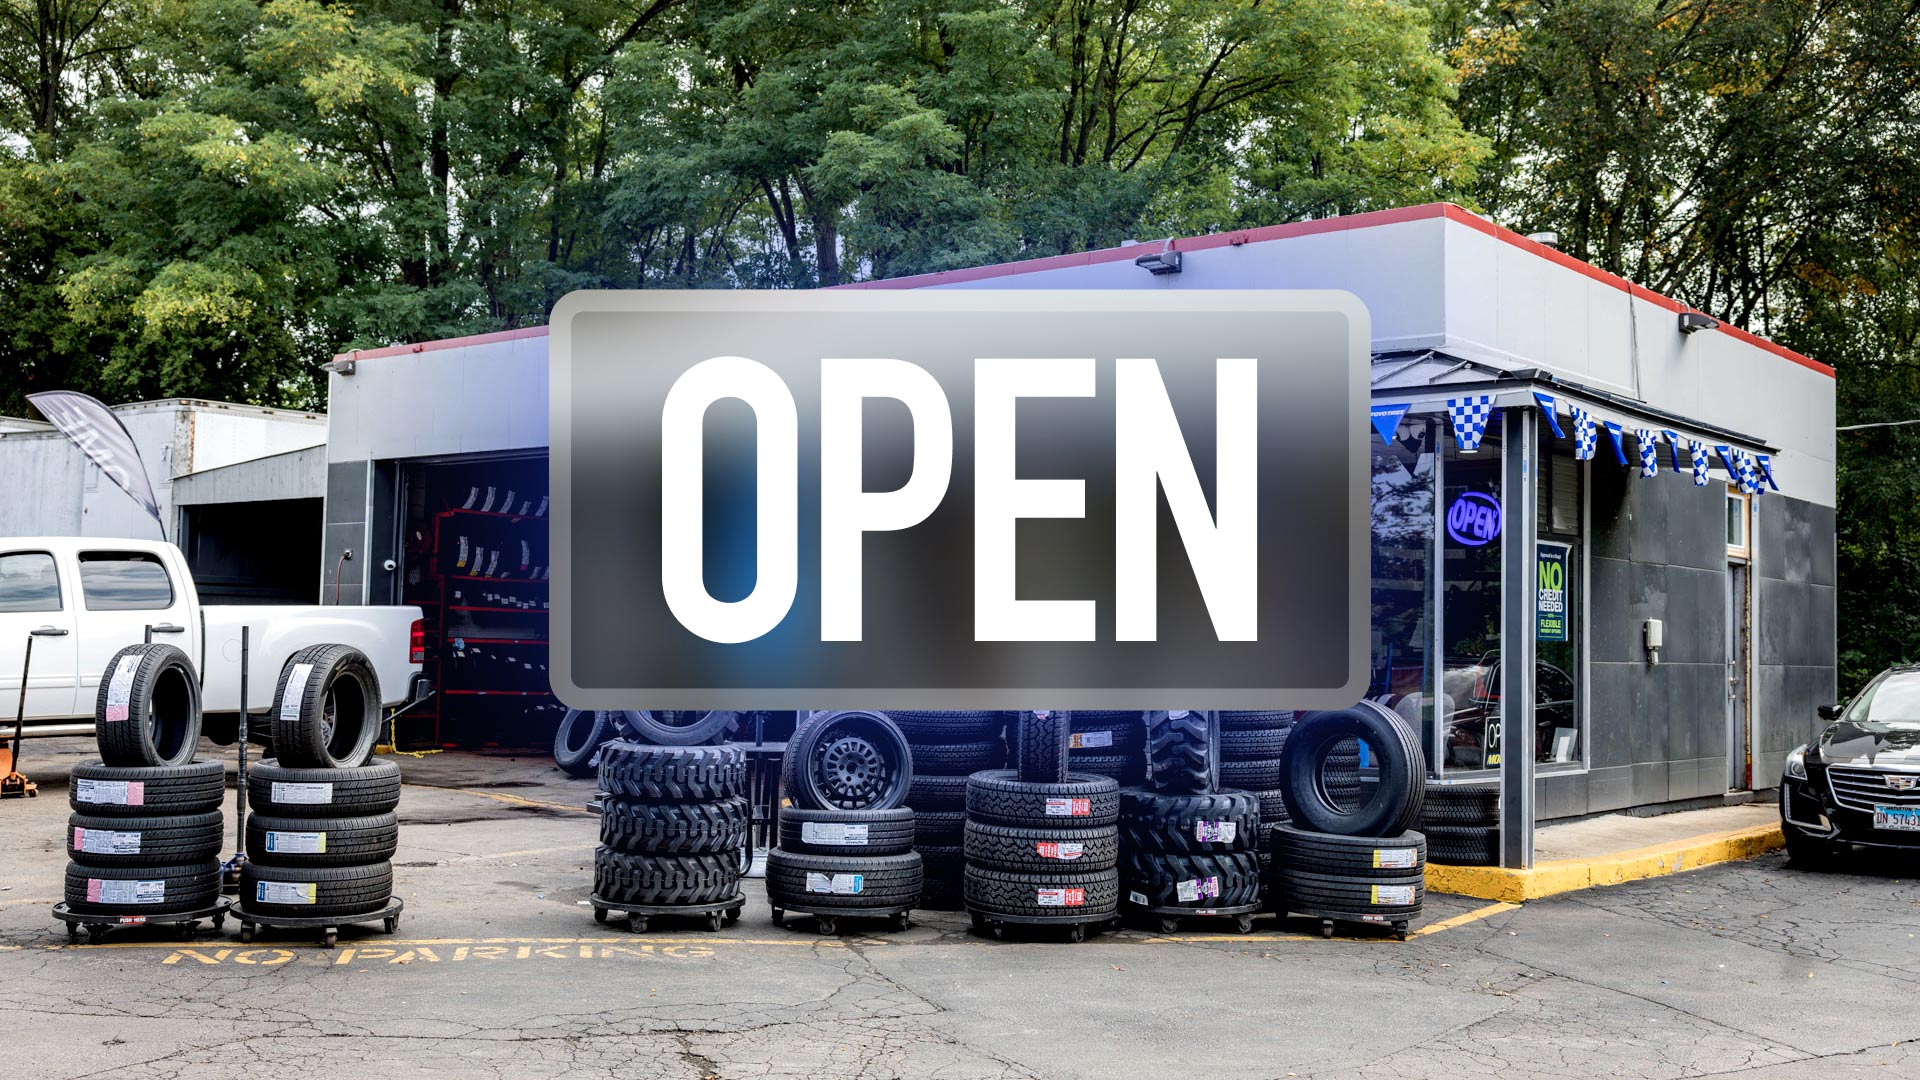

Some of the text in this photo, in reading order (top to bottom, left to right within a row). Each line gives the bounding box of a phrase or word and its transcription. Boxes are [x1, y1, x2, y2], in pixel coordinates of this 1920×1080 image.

[1451, 498, 1497, 540] OPEN
[1538, 560, 1563, 591] NO
[1538, 588, 1563, 602] CREDIT
[1538, 600, 1563, 613] NEEDED
[1540, 619, 1562, 629] FLEXIBLE
[1876, 812, 1888, 824] DN
[161, 945, 715, 965] NO PARKING
